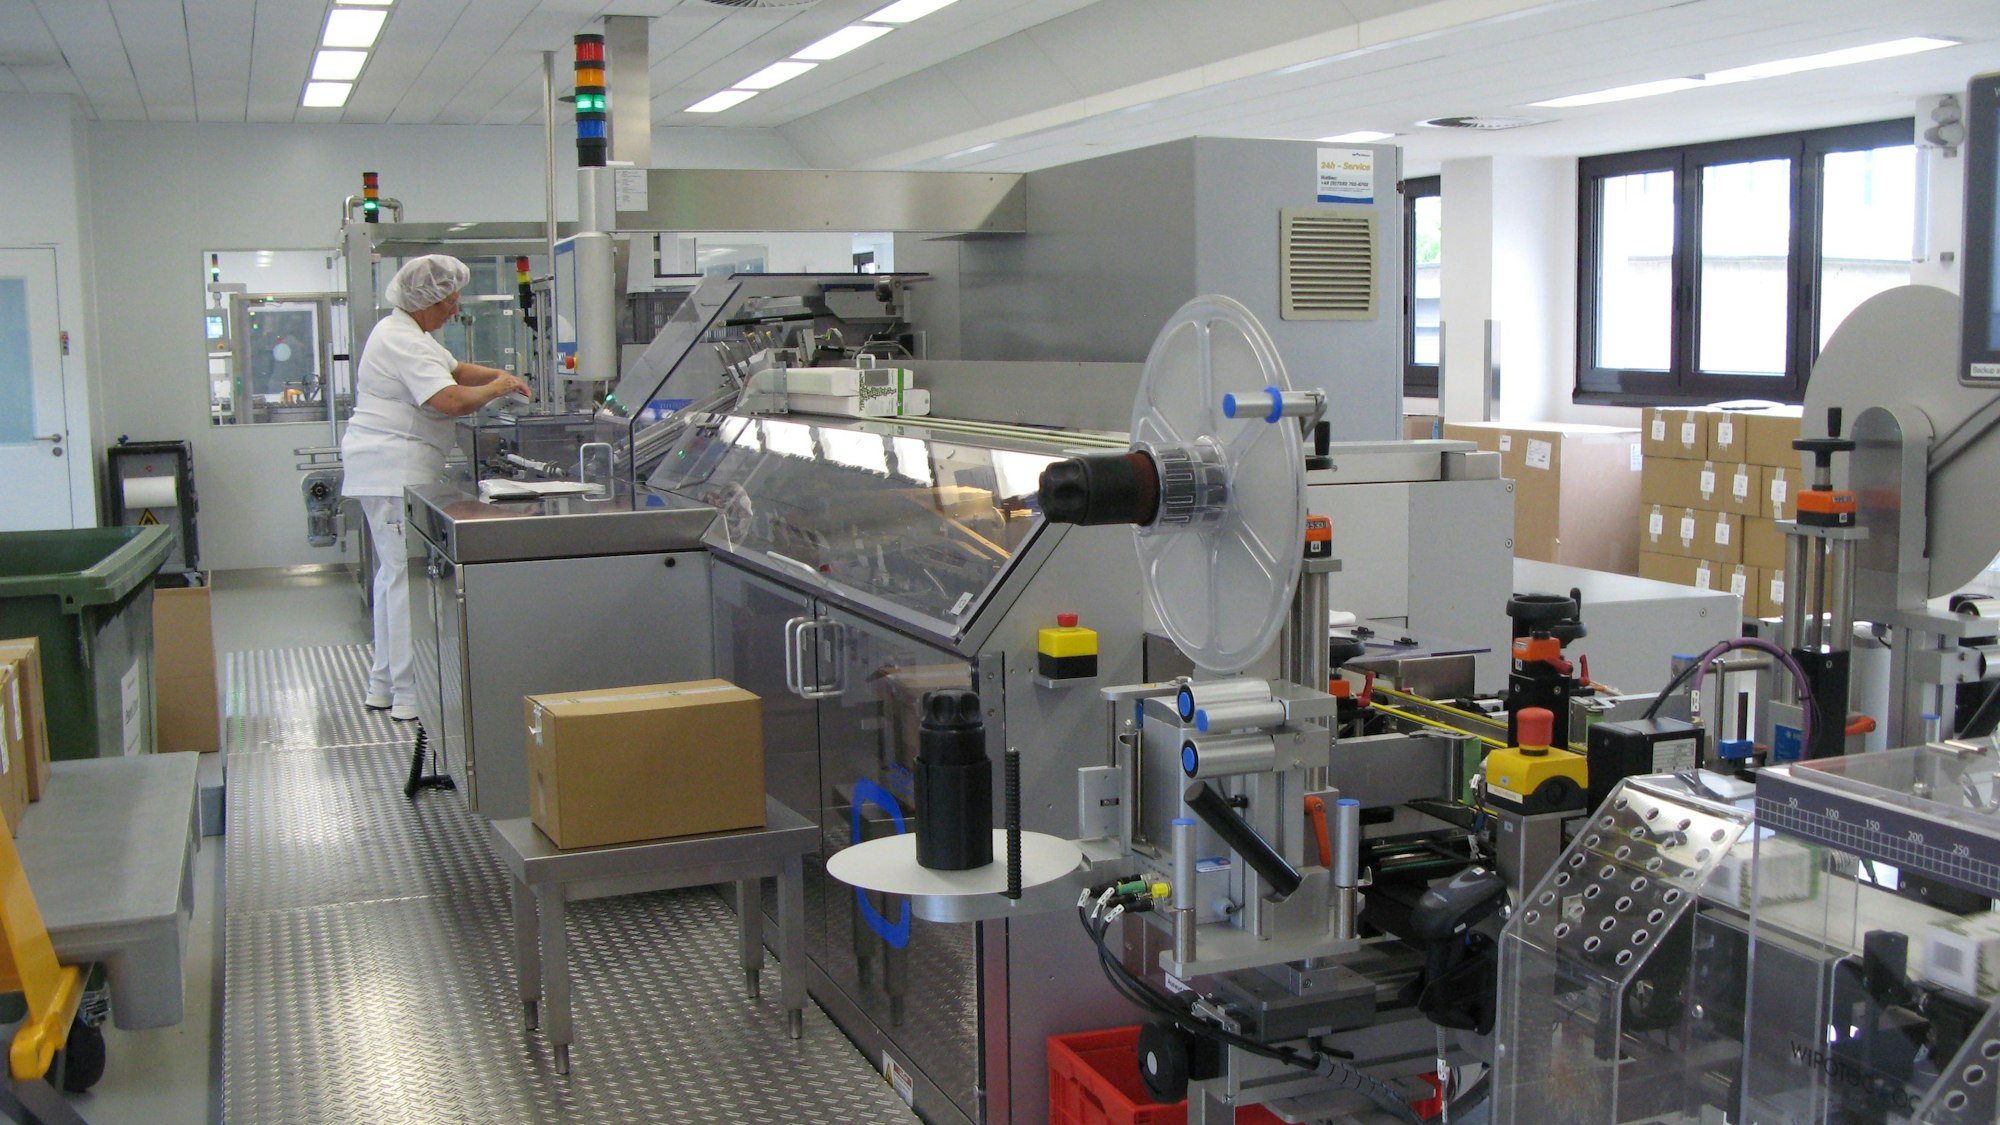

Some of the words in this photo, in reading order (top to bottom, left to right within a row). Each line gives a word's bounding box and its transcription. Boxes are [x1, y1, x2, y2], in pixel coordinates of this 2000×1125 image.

[1320, 161, 1336, 169] 24h
[1343, 161, 1371, 171] Service
[1788, 796, 1798, 808] 50
[1825, 807, 1840, 820] 100
[1865, 819, 1880, 832] 150
[1907, 830, 1924, 844] 200
[1952, 843, 1969, 857] 250
